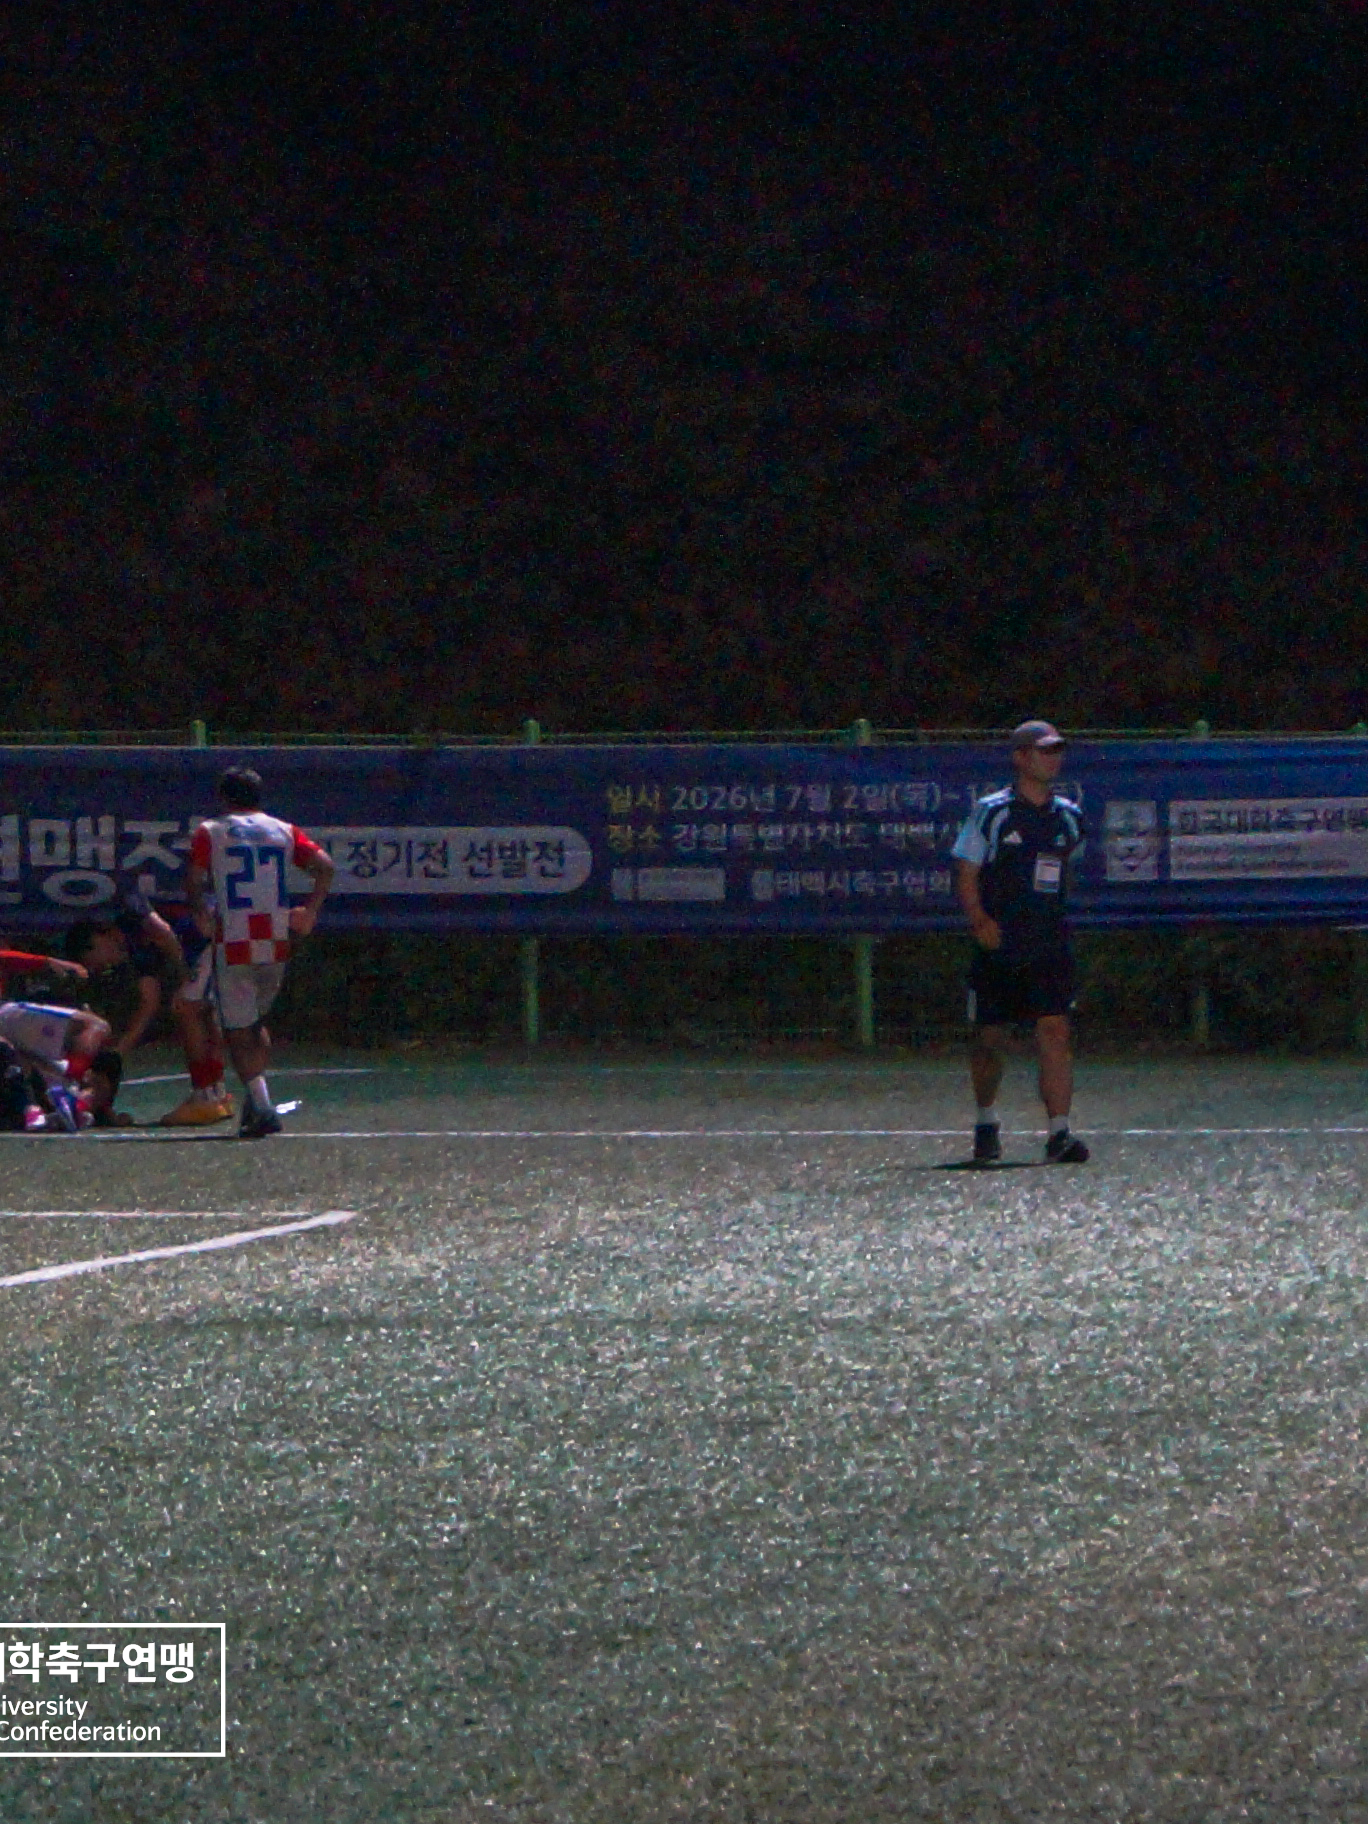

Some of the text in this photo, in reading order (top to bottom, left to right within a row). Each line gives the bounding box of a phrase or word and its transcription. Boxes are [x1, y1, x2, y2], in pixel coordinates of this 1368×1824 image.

[607, 784, 661, 814] 일시
[671, 784, 776, 813] 2026년
[225, 846, 290, 909] 27
[346, 840, 450, 879] 정기전
[463, 839, 565, 879] 선발전
